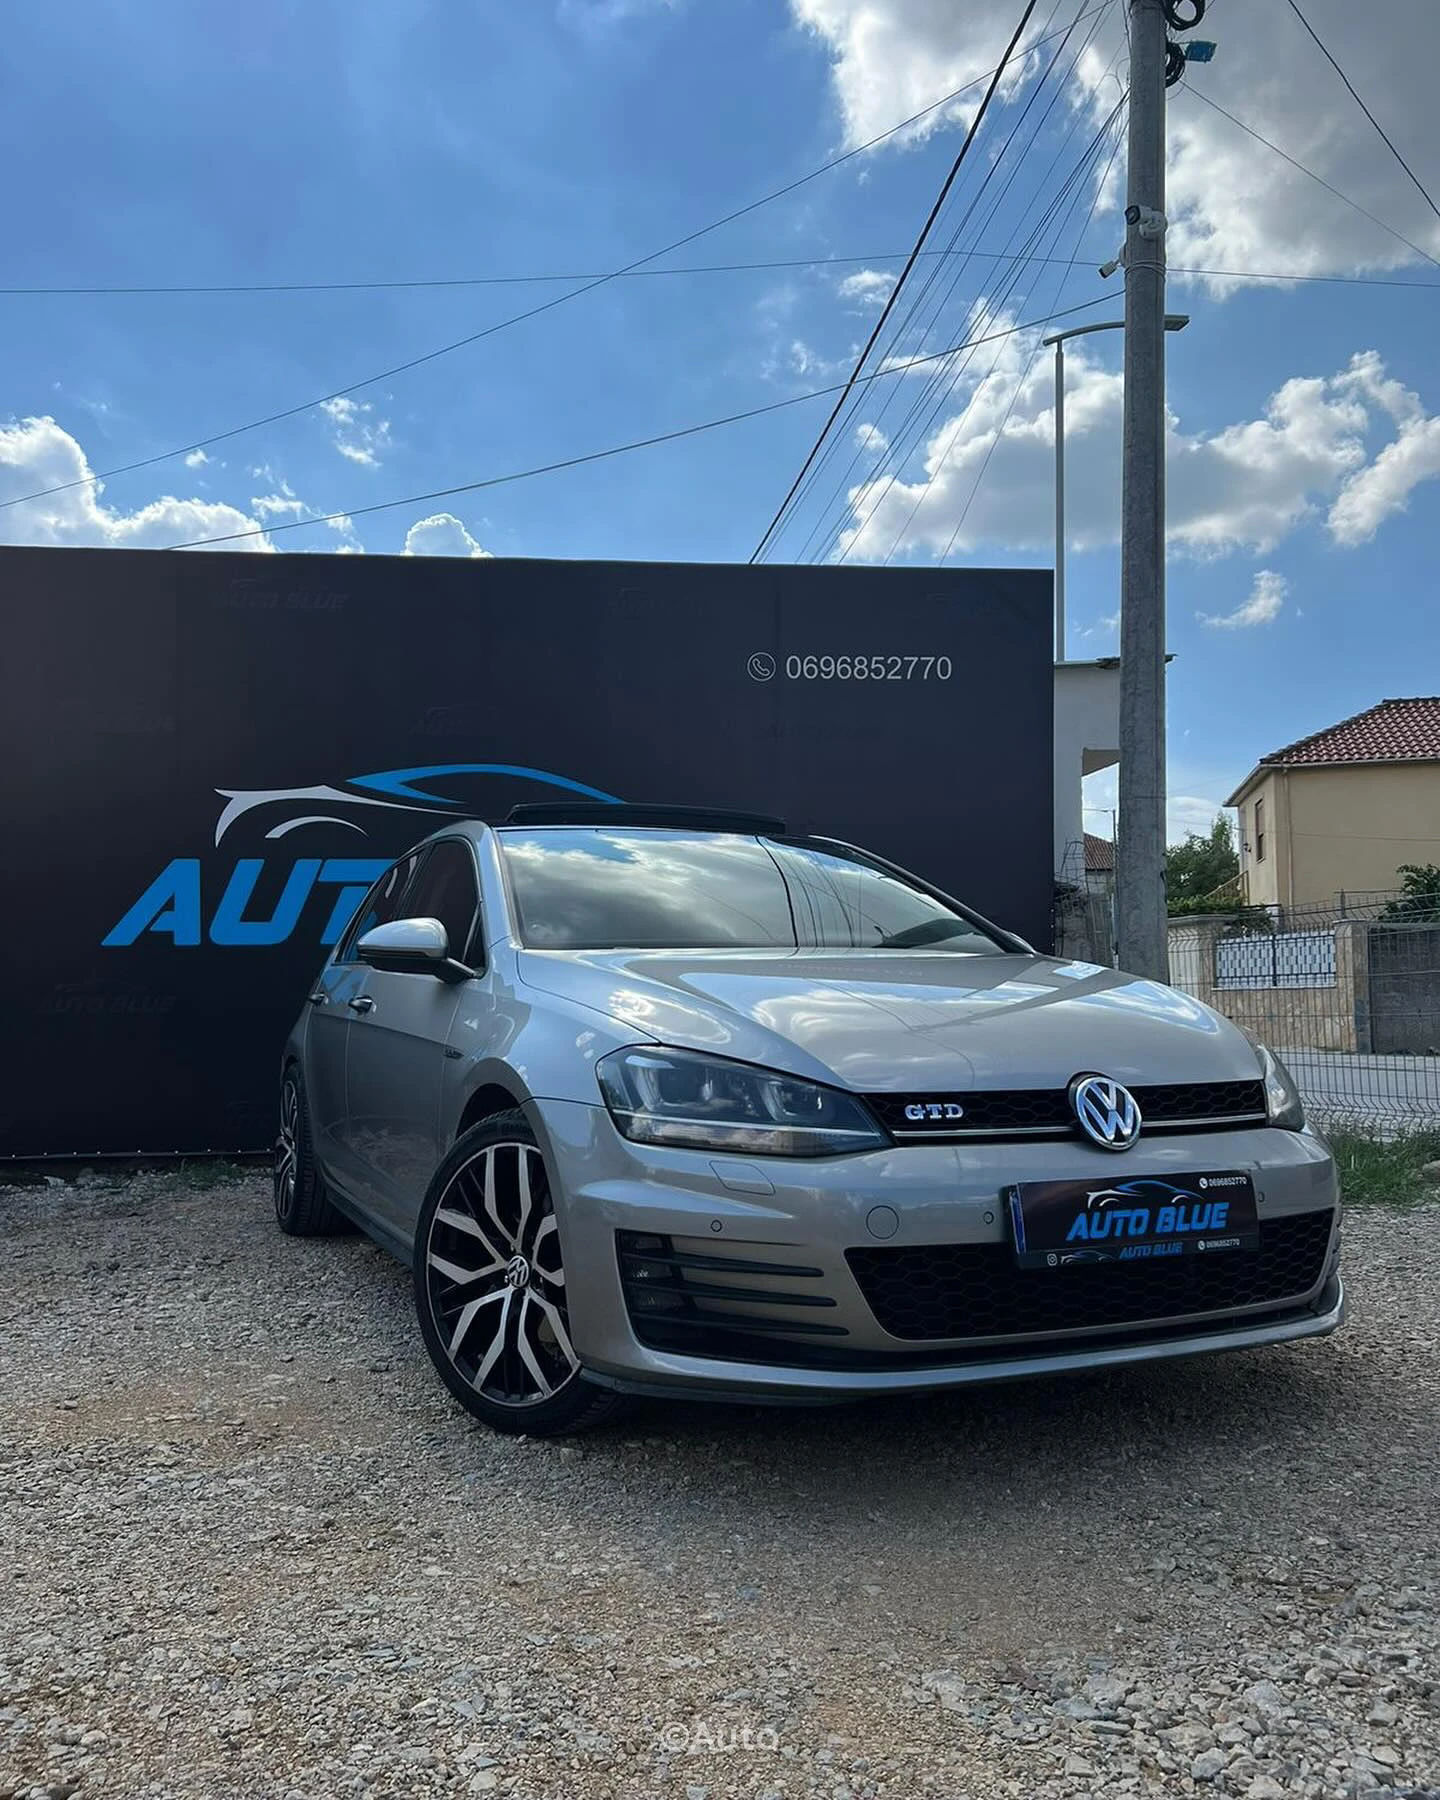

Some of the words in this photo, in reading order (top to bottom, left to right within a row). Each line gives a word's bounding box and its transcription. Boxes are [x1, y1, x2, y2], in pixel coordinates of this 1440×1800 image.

[785, 655, 953, 680] 0696852770
[101, 858, 400, 946] AUT
[903, 1103, 964, 1121] GTD
[1066, 1208, 1150, 1241] AUTO
[1156, 1202, 1230, 1234] BLUE
[1119, 1245, 1152, 1260] AUTO
[1152, 1241, 1184, 1256] BLUE
